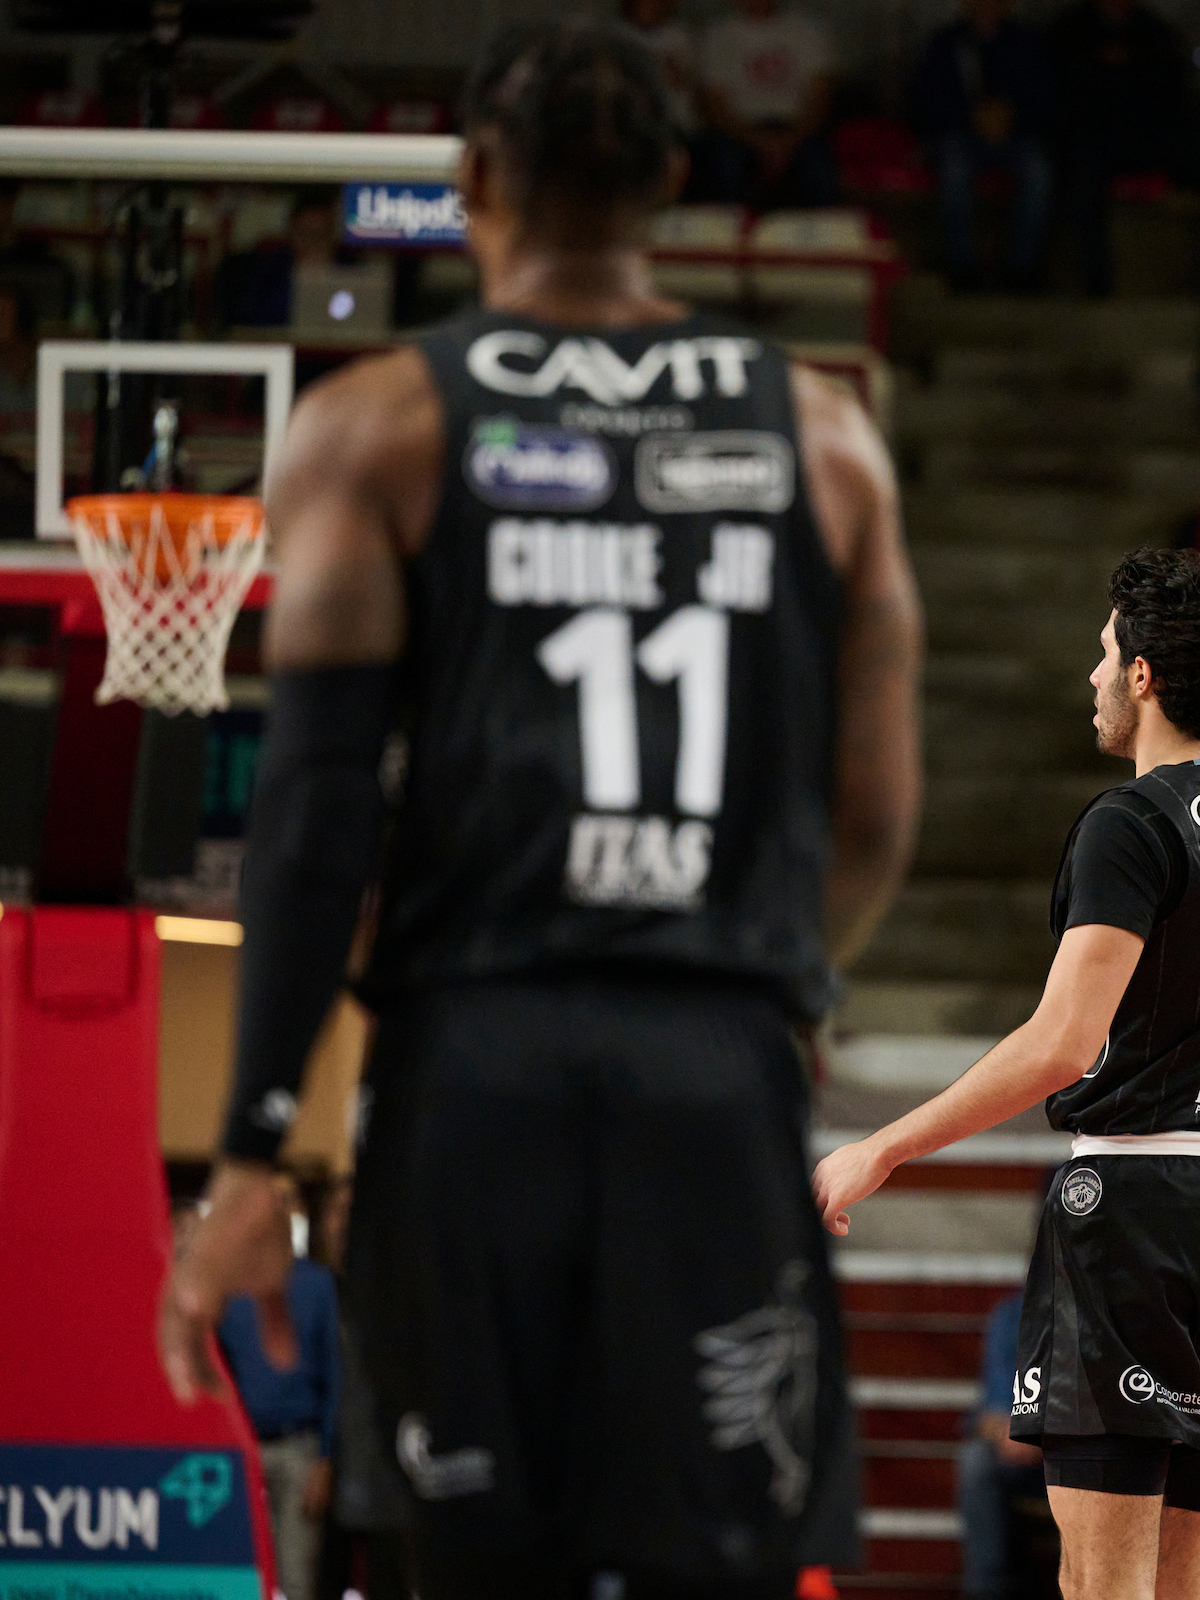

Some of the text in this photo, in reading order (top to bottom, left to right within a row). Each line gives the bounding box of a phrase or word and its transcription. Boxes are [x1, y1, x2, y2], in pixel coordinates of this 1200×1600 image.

[467, 330, 761, 403] CAVIT
[535, 604, 731, 817] 11
[0, 1485, 159, 1549] LYUM
